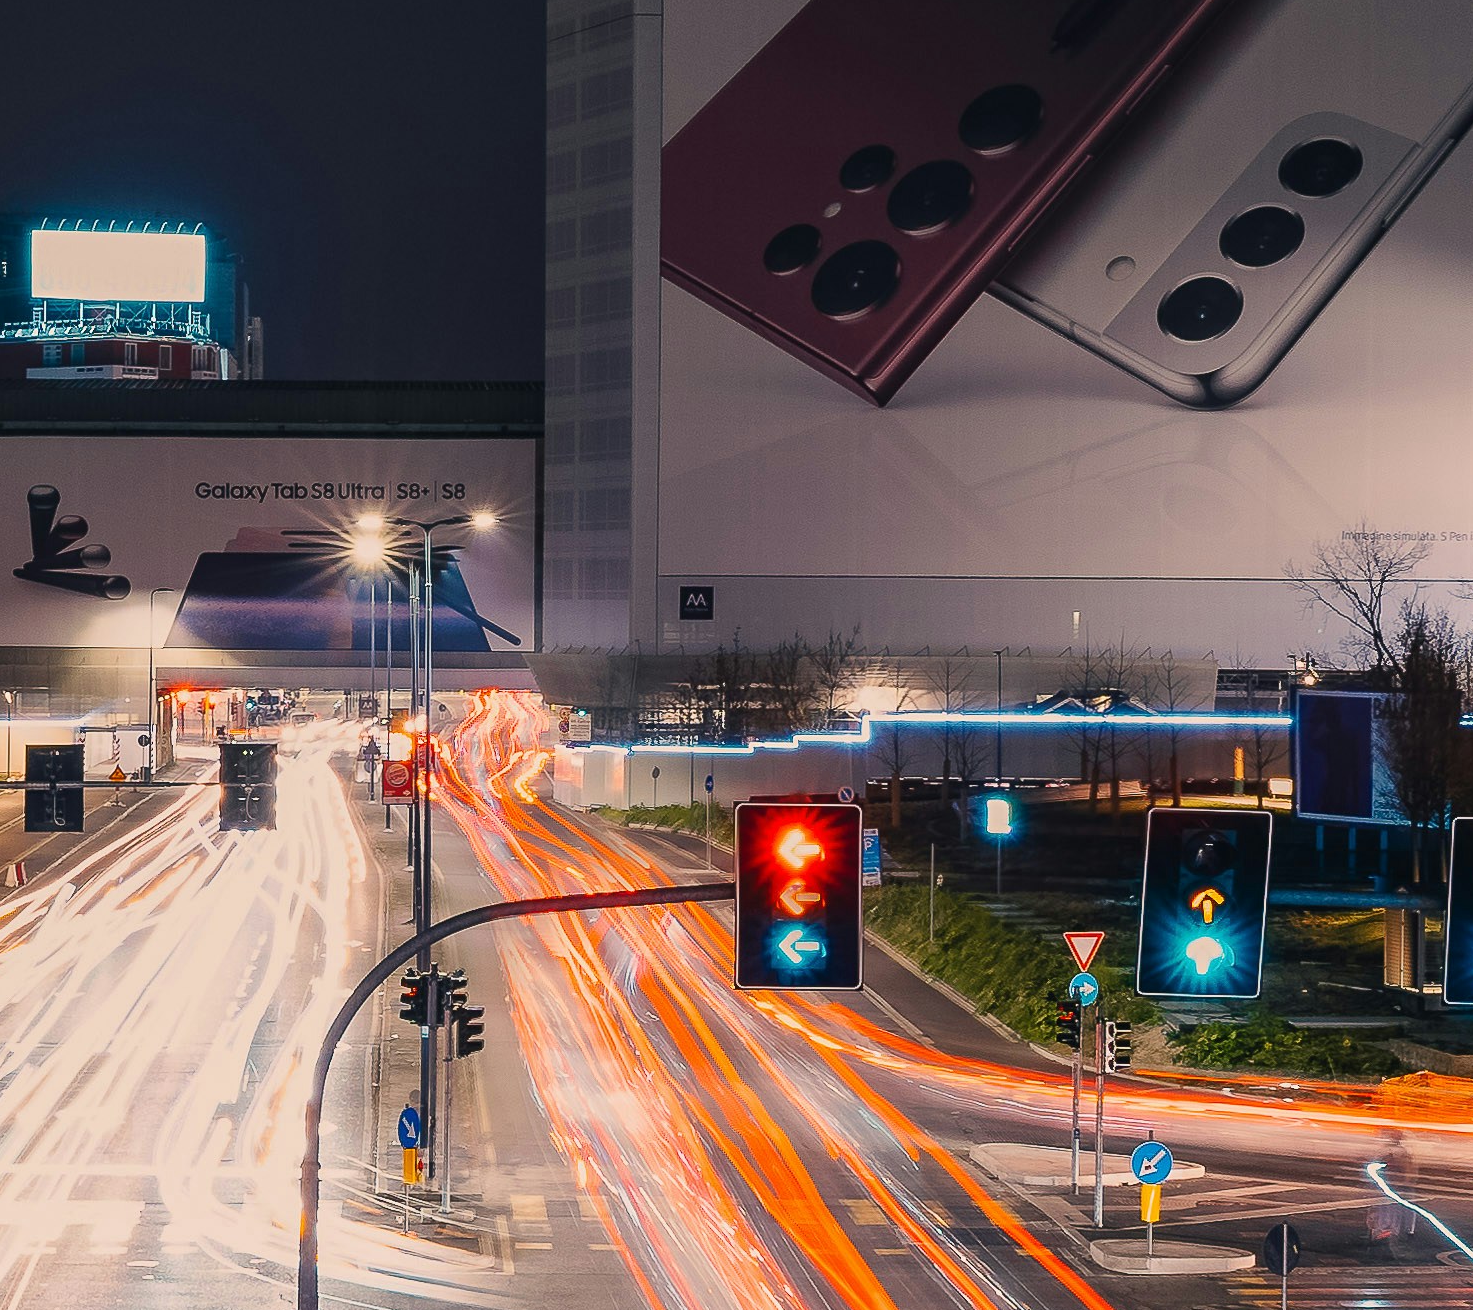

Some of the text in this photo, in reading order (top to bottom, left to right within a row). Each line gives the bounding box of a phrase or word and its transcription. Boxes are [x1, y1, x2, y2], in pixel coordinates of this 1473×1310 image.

[194, 482, 466, 503] Galaxy Tab S8 Ultra S8+ S8
[1450, 531, 1468, 541] Pen
